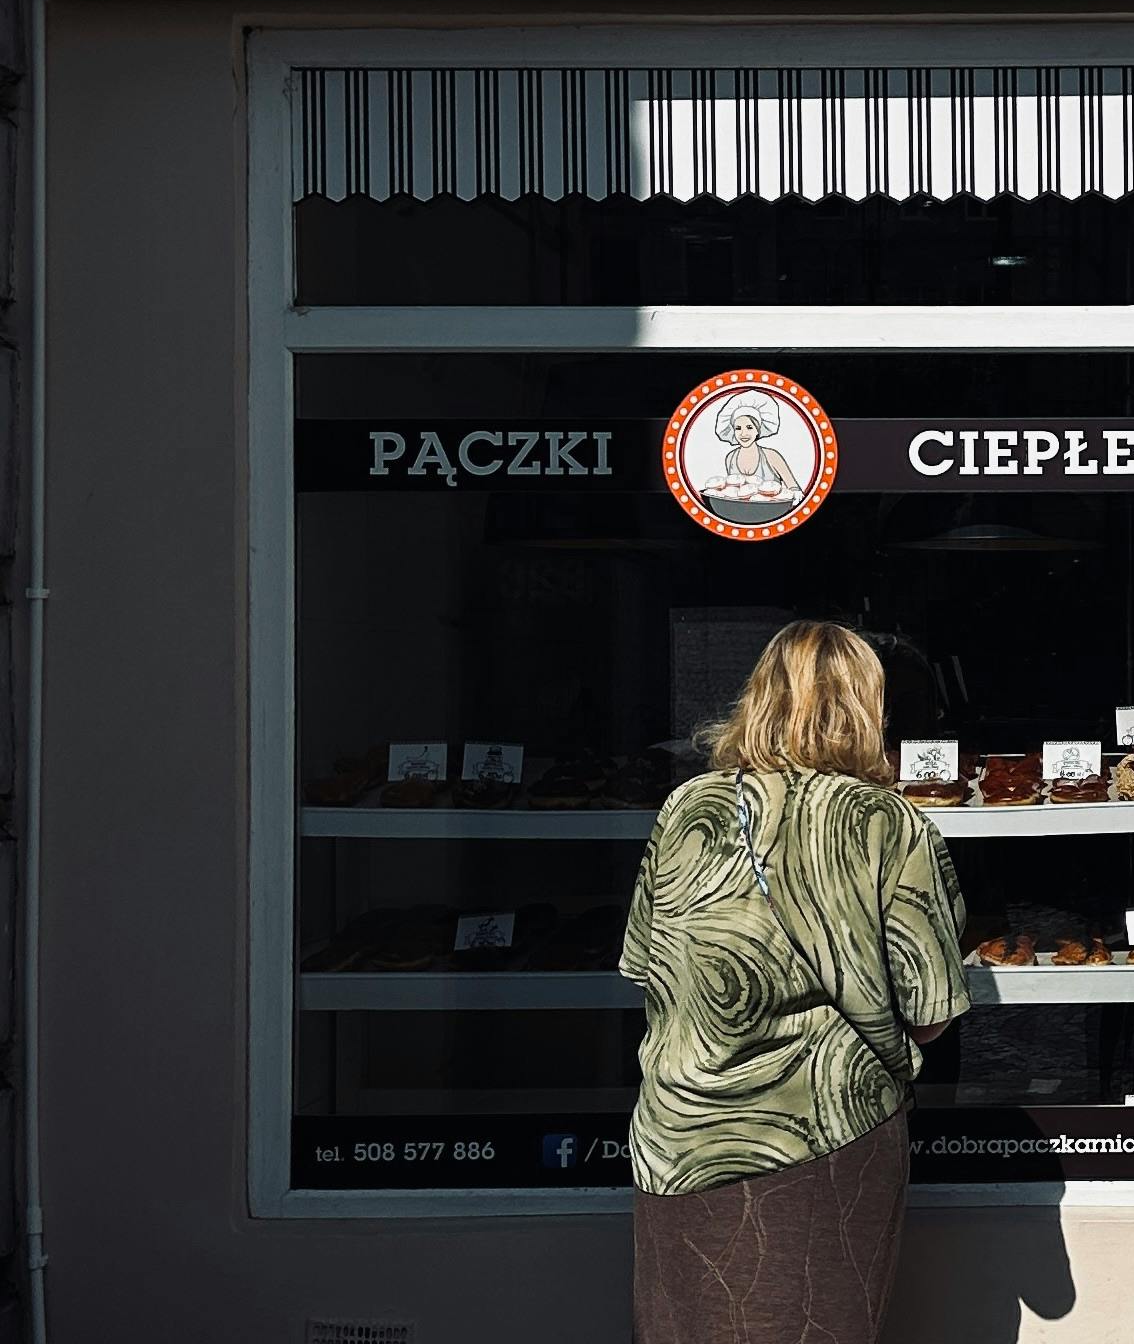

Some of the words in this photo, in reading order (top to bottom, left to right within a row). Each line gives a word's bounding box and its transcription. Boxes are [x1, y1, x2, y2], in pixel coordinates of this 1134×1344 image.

[368, 430, 614, 488] PĄCZKI
[315, 1145, 345, 1162] tel.
[353, 1142, 396, 1162] 508
[403, 1142, 446, 1161] 577
[453, 1141, 496, 1161] 886
